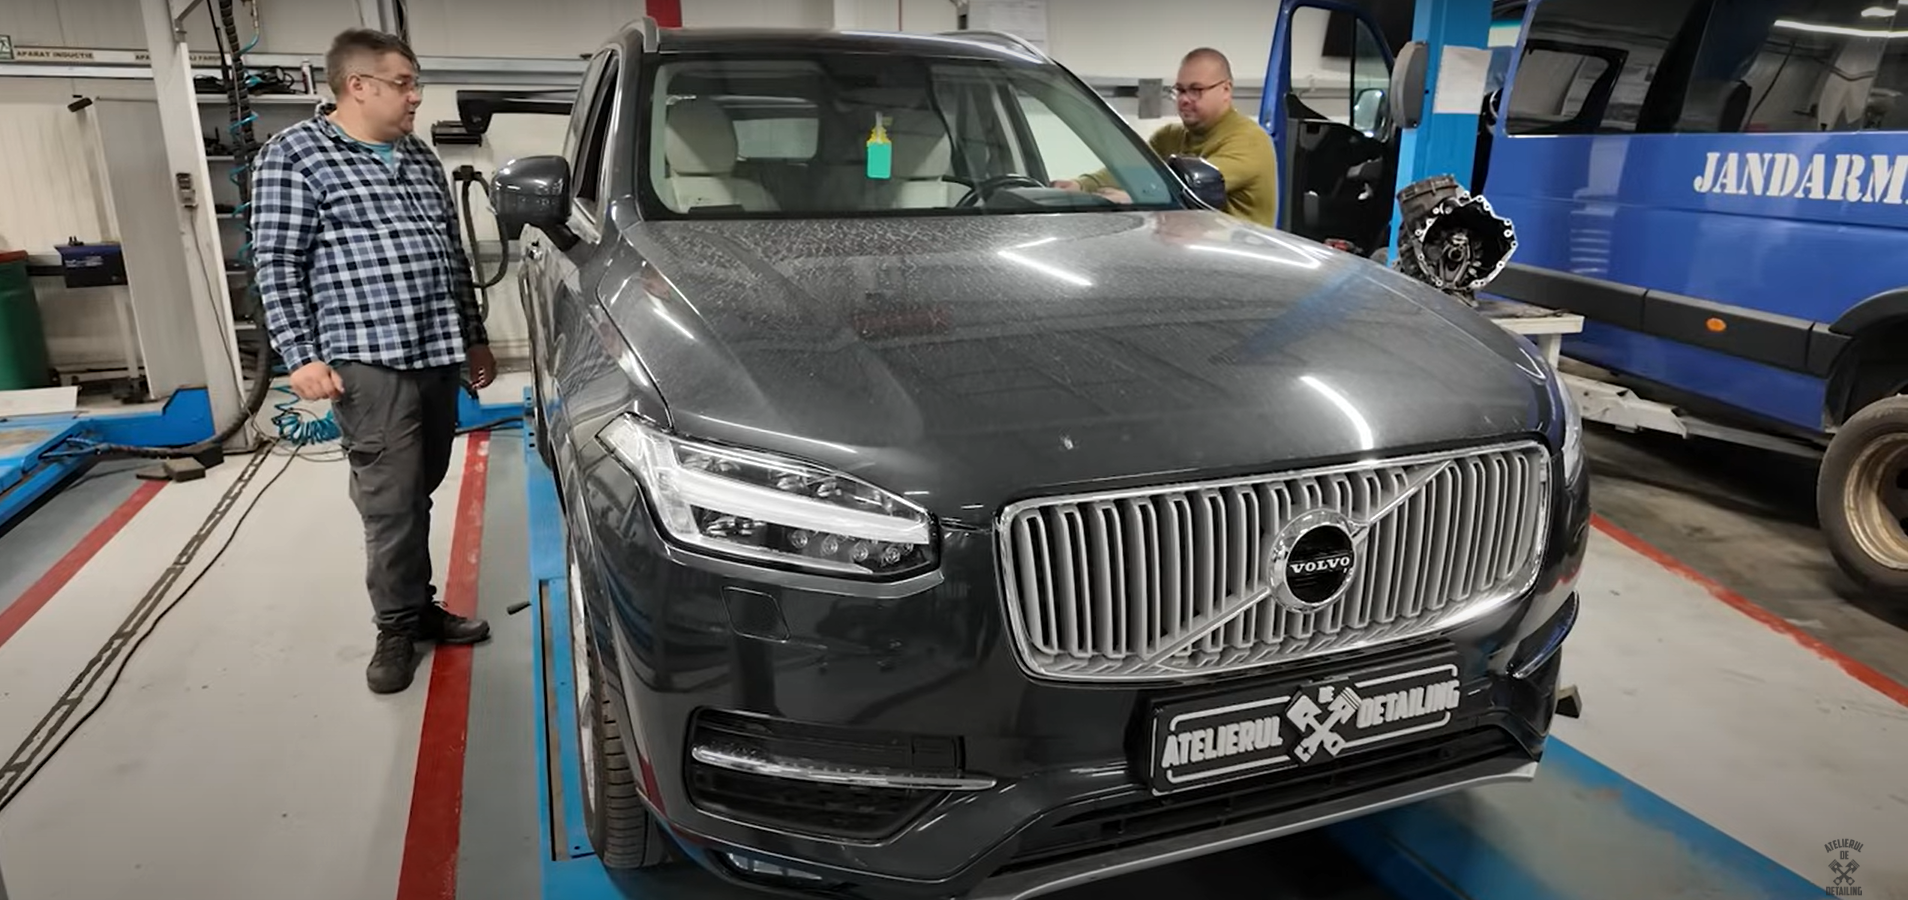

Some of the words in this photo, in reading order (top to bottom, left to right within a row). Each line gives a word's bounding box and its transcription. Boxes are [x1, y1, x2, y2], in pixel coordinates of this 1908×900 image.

[1693, 152, 1908, 204] JANDARM
[1290, 557, 1350, 573] VOLVO
[1161, 716, 1283, 768] ATELIERUL
[1318, 685, 1335, 703] DE
[1356, 680, 1460, 728] DETAILING
